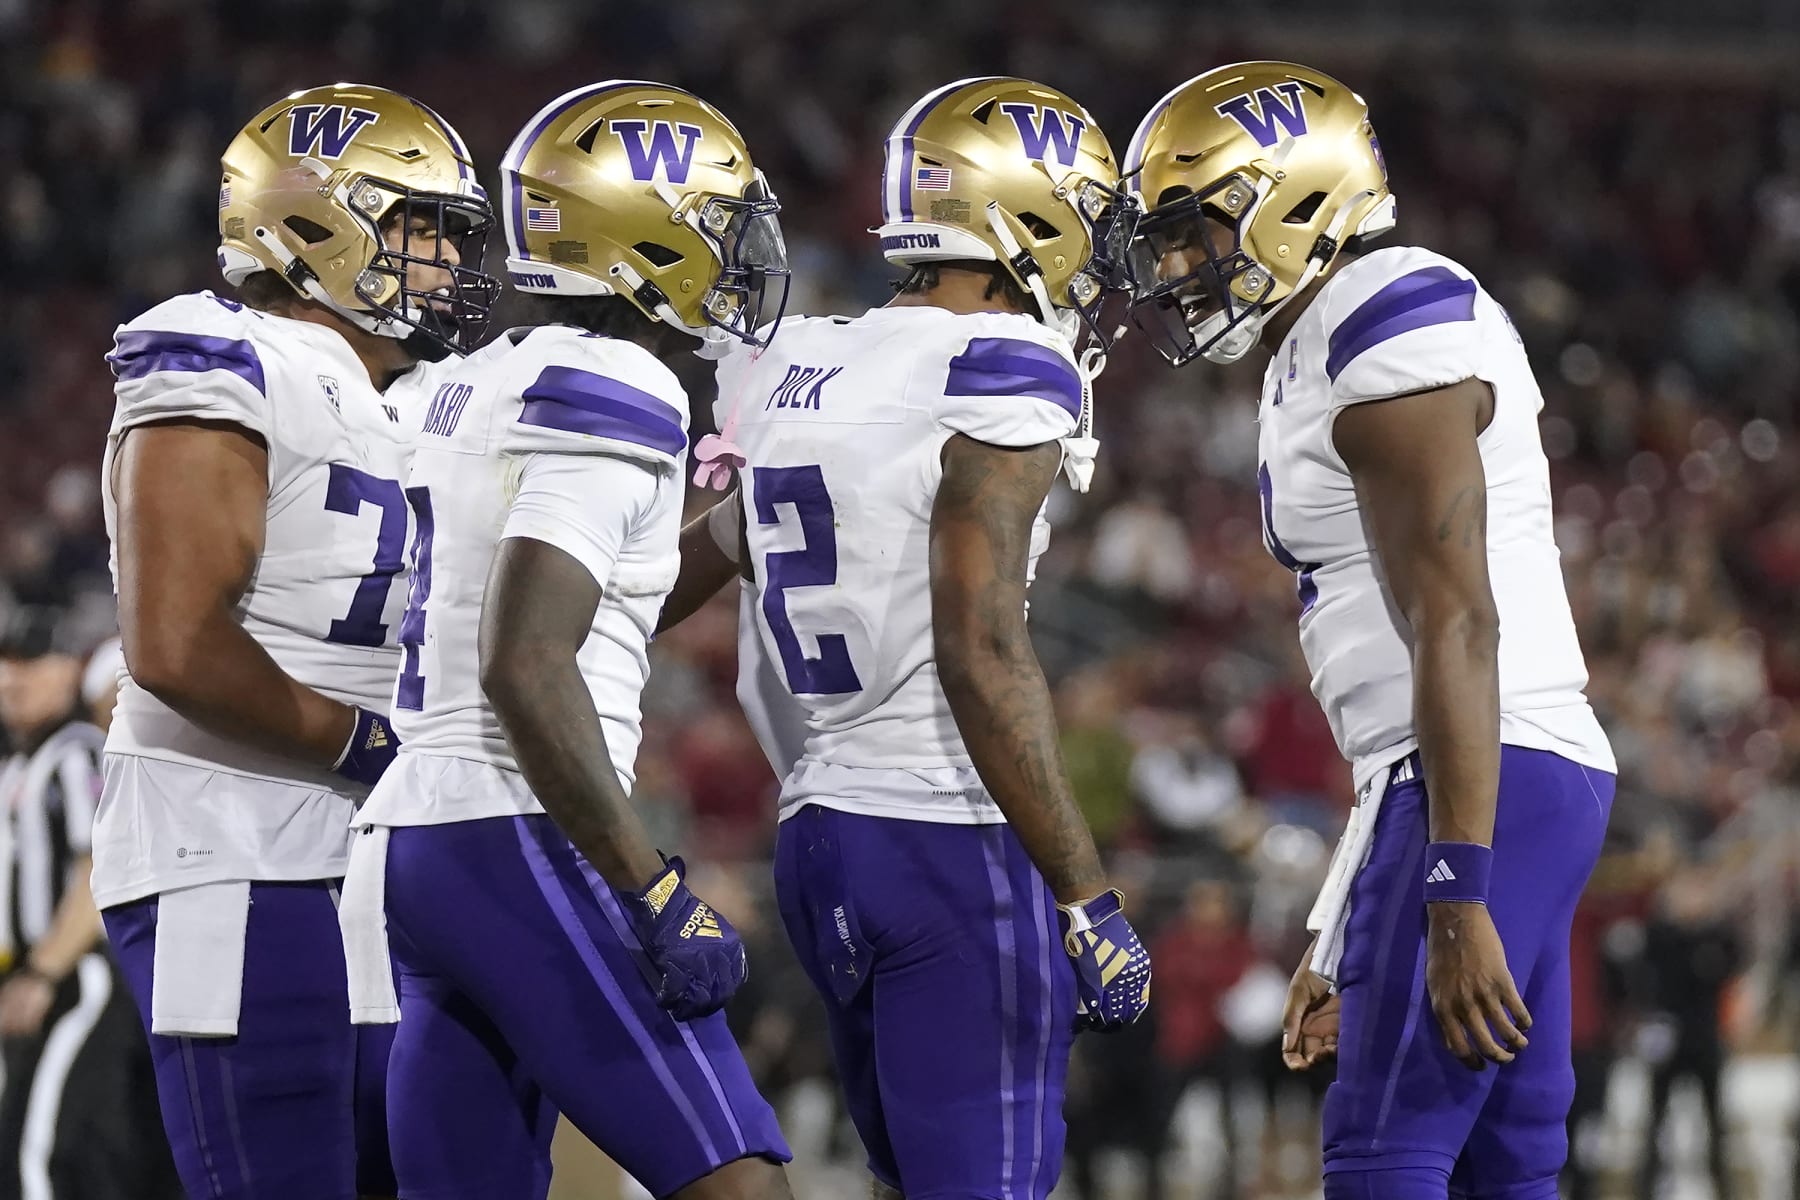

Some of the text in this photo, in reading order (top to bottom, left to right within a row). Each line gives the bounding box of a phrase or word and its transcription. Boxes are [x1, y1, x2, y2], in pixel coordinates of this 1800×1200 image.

[287, 104, 380, 160] W
[999, 102, 1088, 168] W
[1213, 80, 1306, 148] W
[609, 119, 703, 186] W
[381, 404, 399, 423] W
[765, 364, 844, 412] POLK
[320, 463, 408, 647] 7
[753, 465, 863, 694] 2
